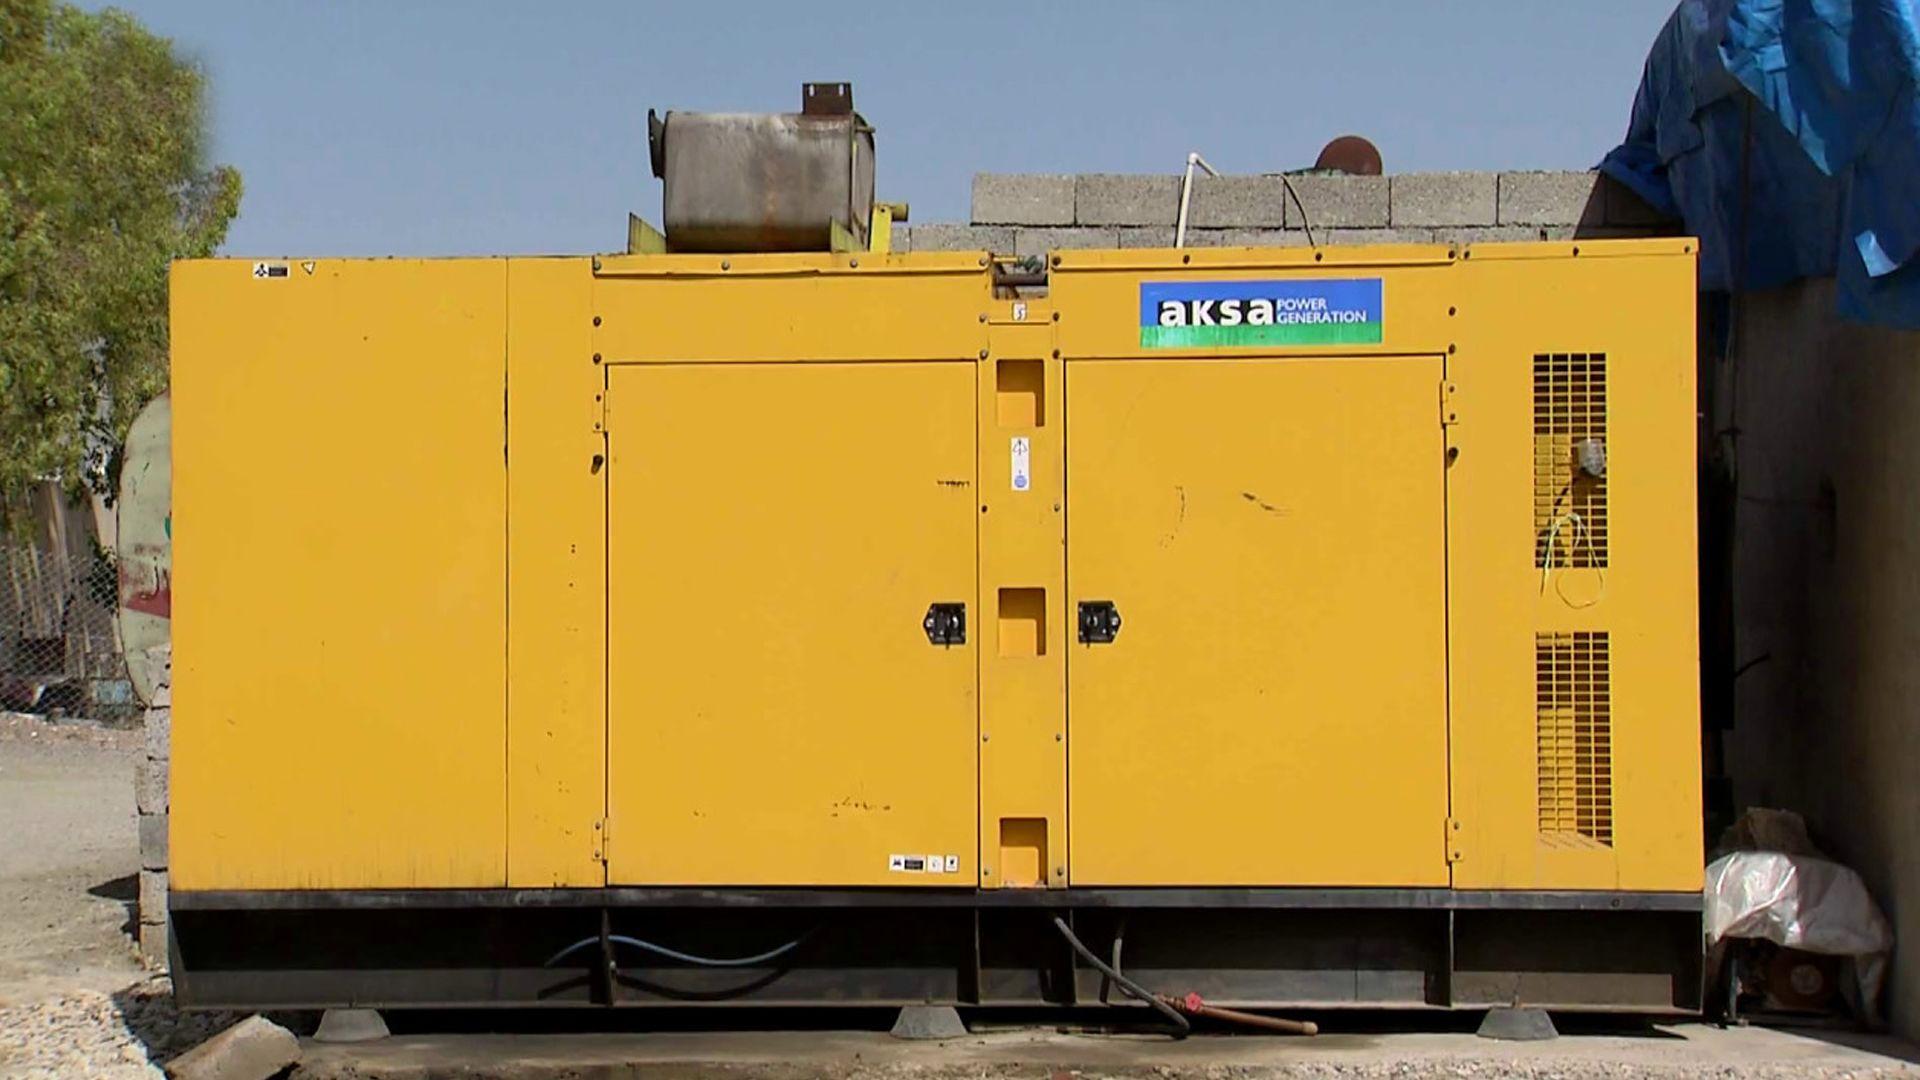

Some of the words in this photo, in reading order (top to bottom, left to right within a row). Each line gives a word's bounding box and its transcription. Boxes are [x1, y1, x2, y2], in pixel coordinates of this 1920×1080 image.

[1277, 298, 1328, 311] POWER
[1159, 299, 1275, 327] aksa
[1277, 311, 1367, 324] GENERATION
